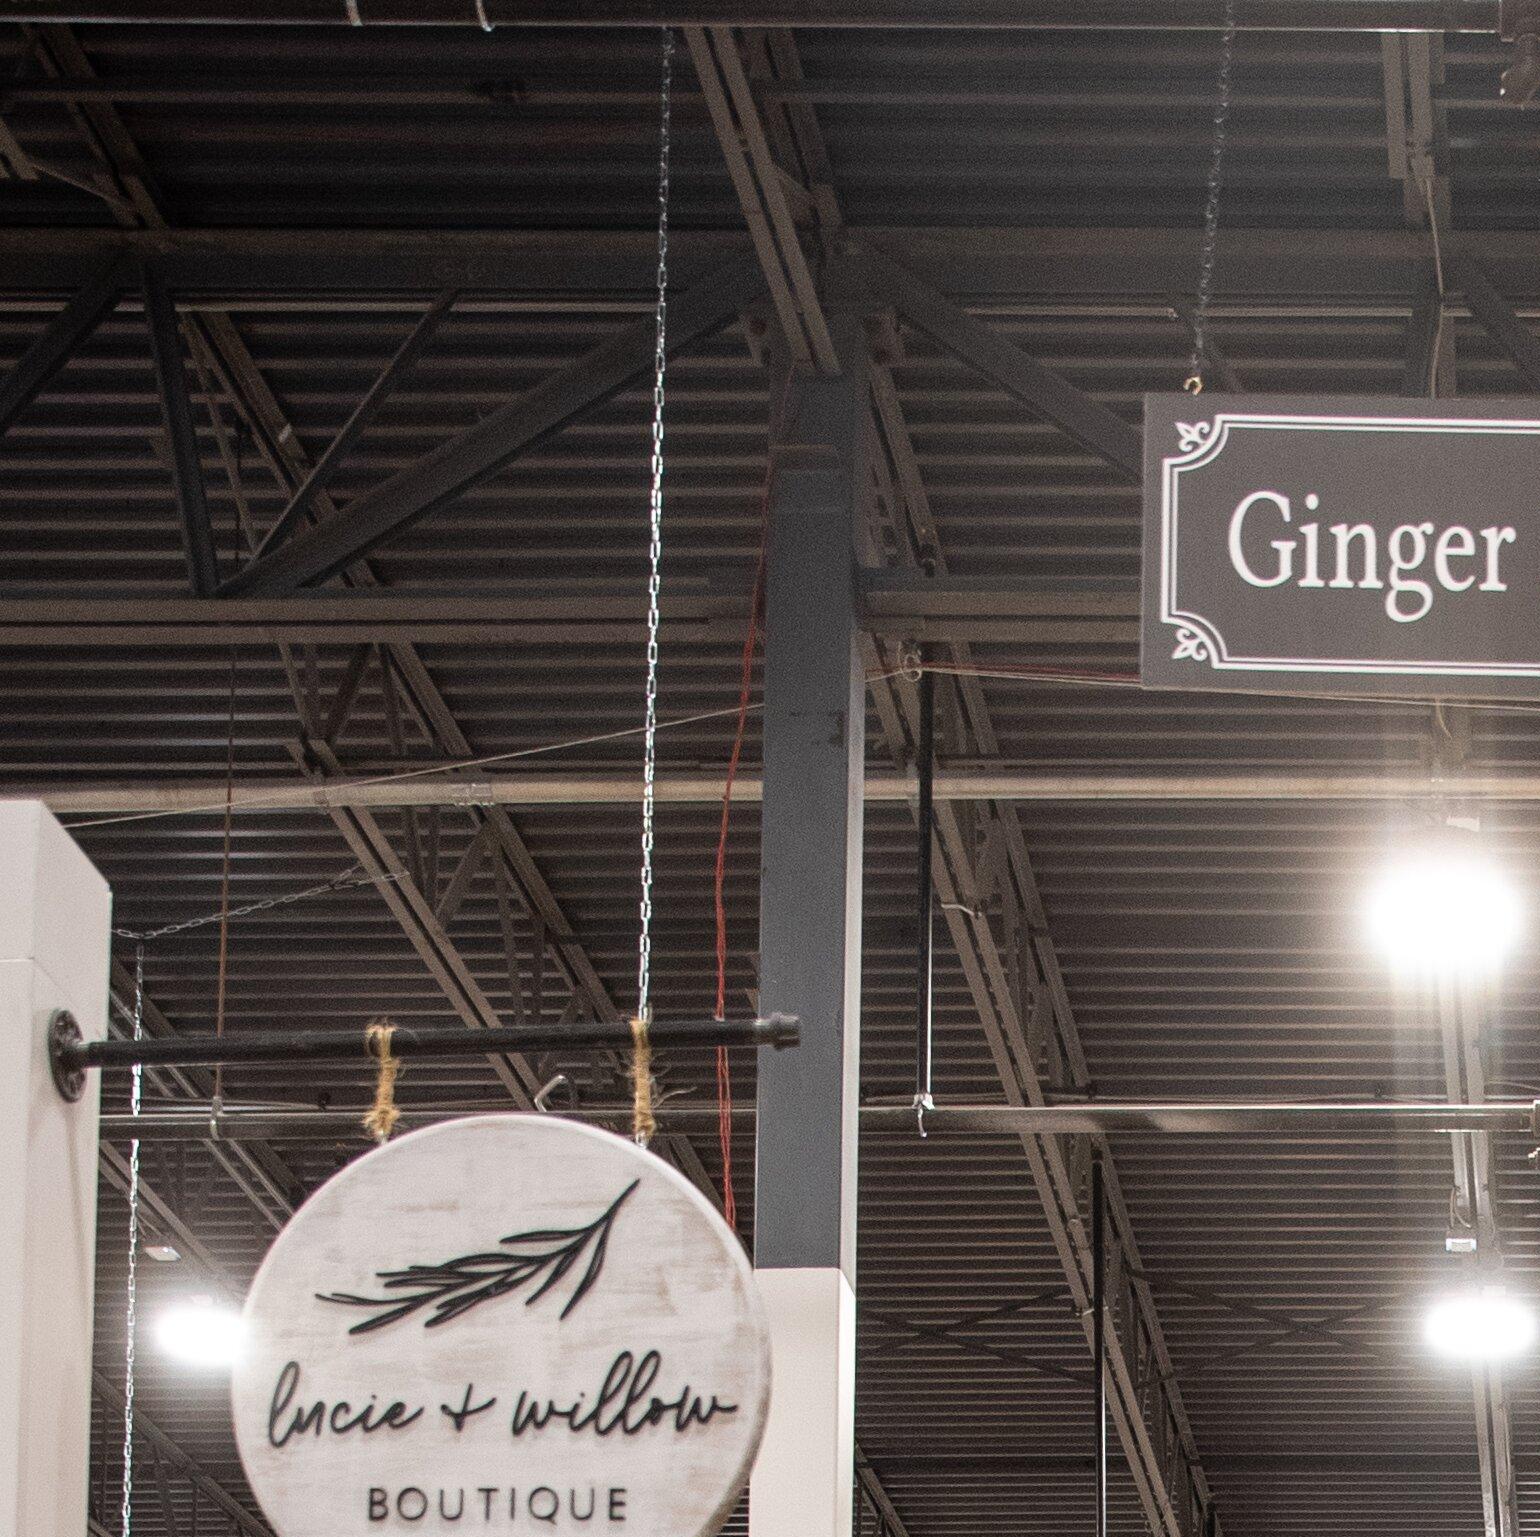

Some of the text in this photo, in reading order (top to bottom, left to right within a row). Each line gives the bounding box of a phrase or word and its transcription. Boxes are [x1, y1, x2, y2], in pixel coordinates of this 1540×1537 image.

[1227, 490, 1516, 623] Ginger
[268, 1361, 424, 1449] lucie
[511, 1350, 739, 1437] willow
[368, 1486, 627, 1525] BOUTIQUE
